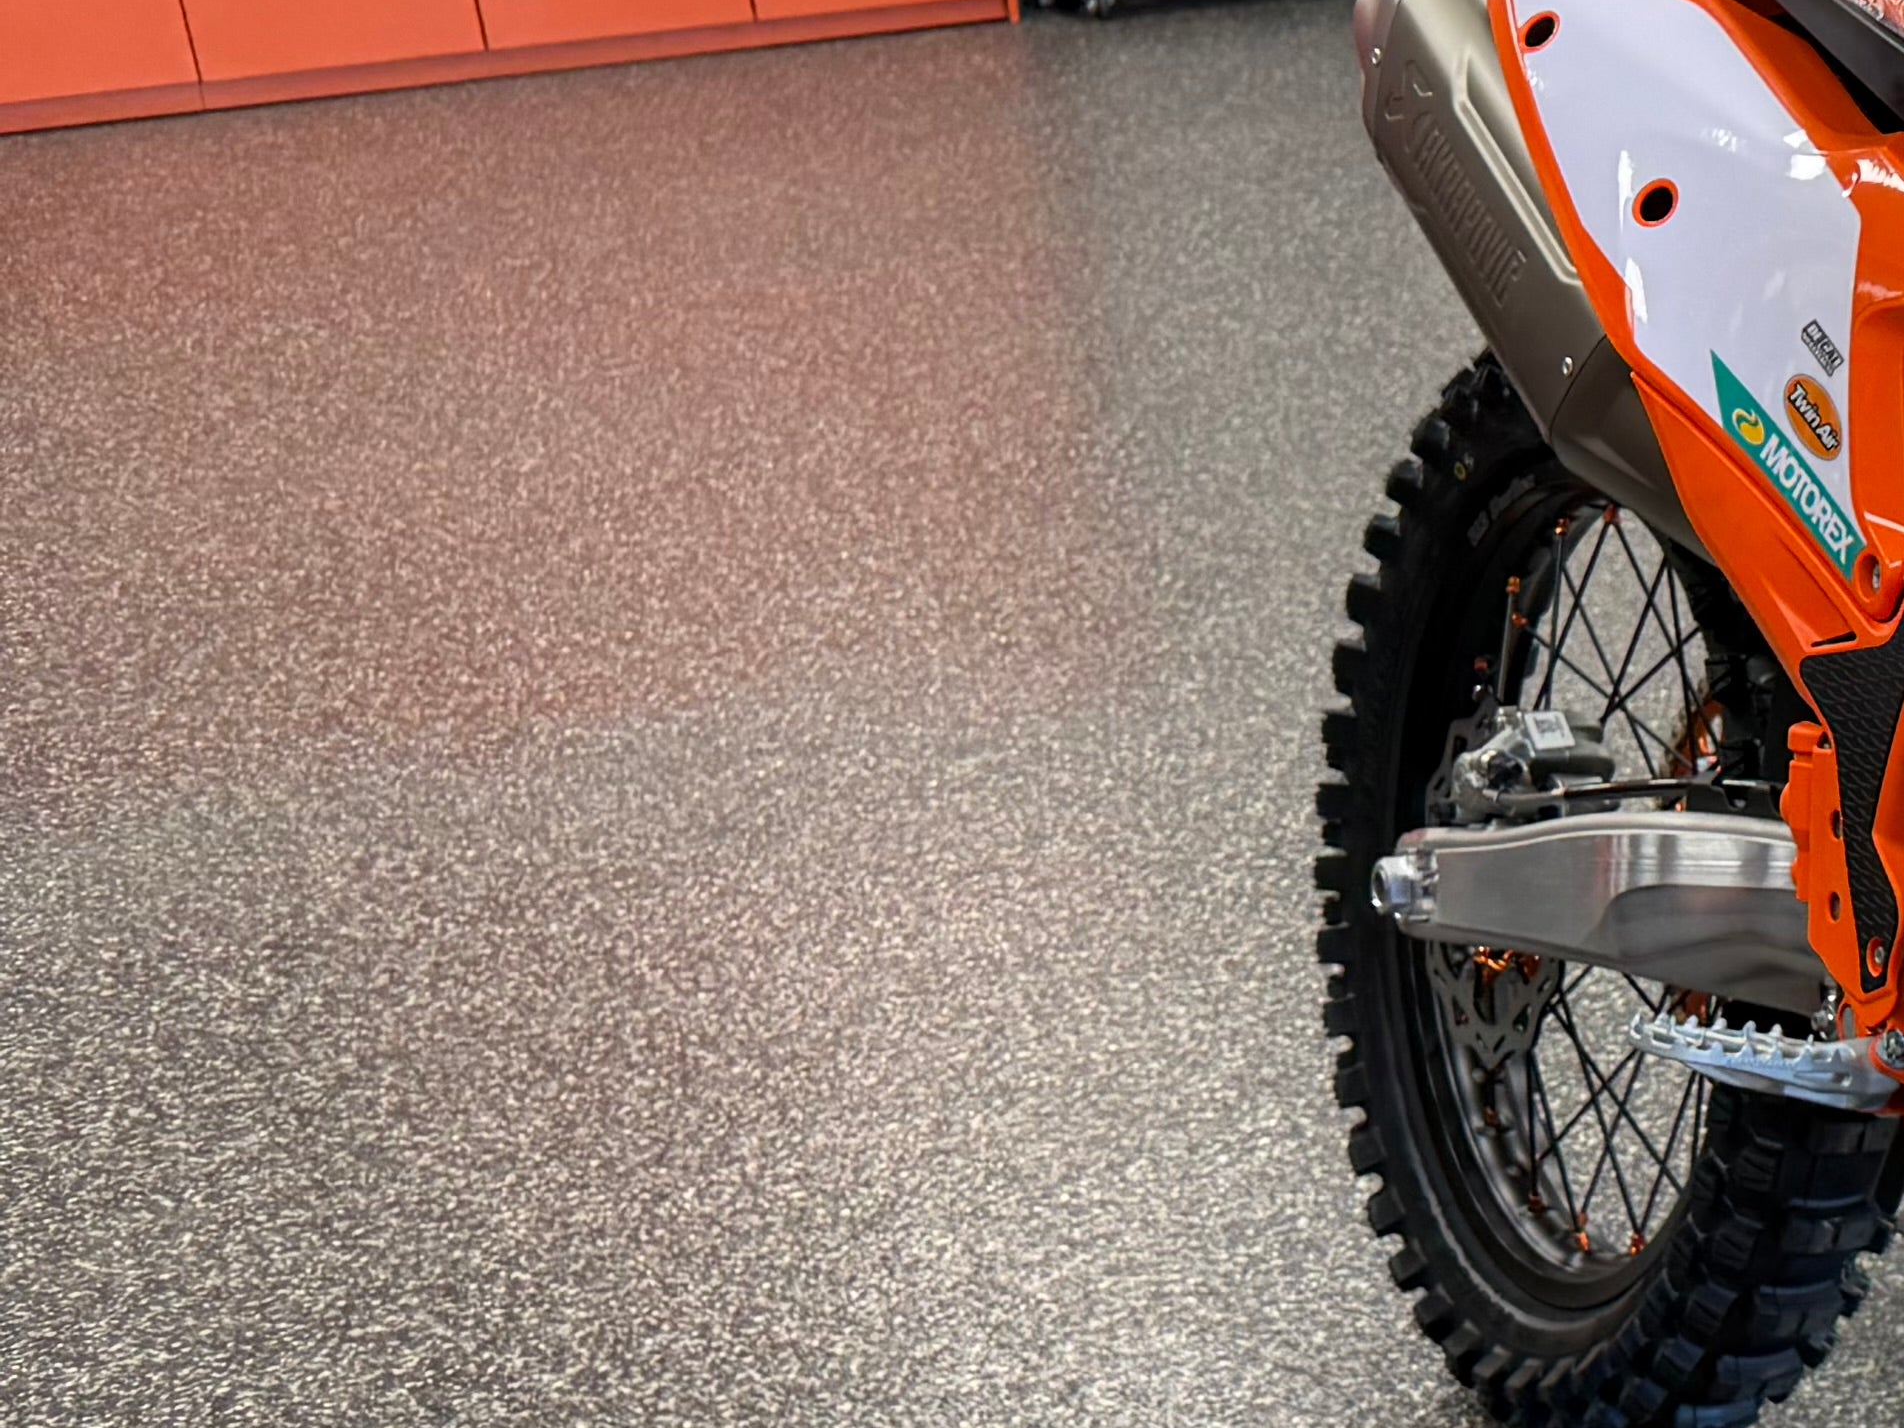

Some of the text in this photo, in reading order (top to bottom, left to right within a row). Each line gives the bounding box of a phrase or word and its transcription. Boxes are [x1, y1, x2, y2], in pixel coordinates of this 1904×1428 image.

[1789, 383, 1821, 429] Twin
[1815, 424, 1839, 450] Air
[1759, 433, 1854, 565] MOTOREX
